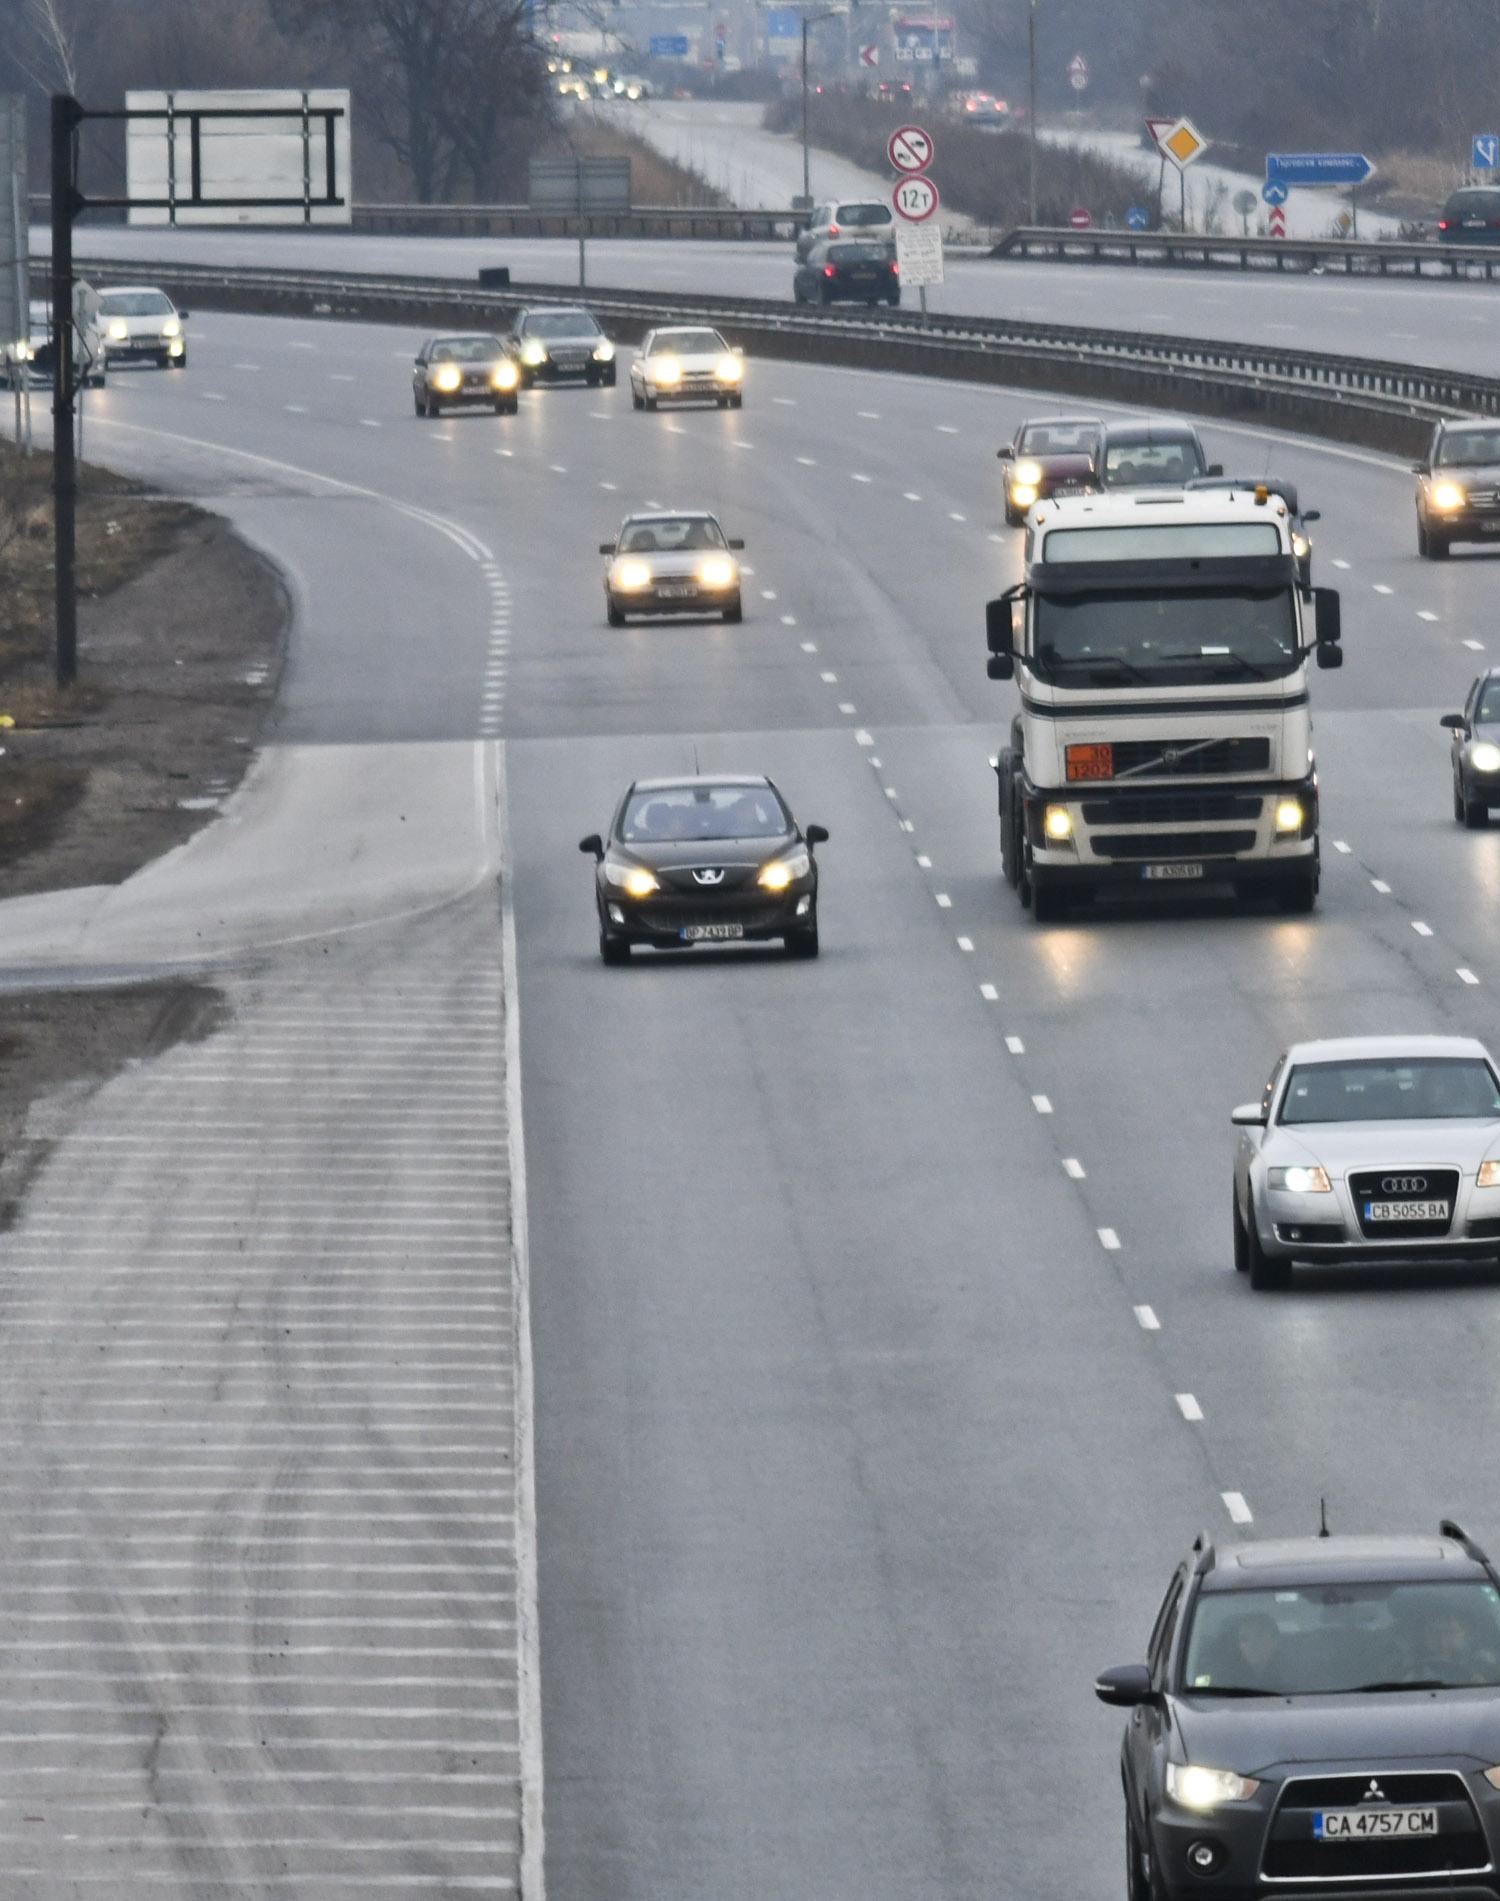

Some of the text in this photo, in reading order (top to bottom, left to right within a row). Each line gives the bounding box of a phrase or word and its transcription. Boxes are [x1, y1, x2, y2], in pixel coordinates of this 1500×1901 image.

[1372, 1201, 1446, 1218] CB 5055 BA
[1325, 1812, 1434, 1835] CA 4757 CM
